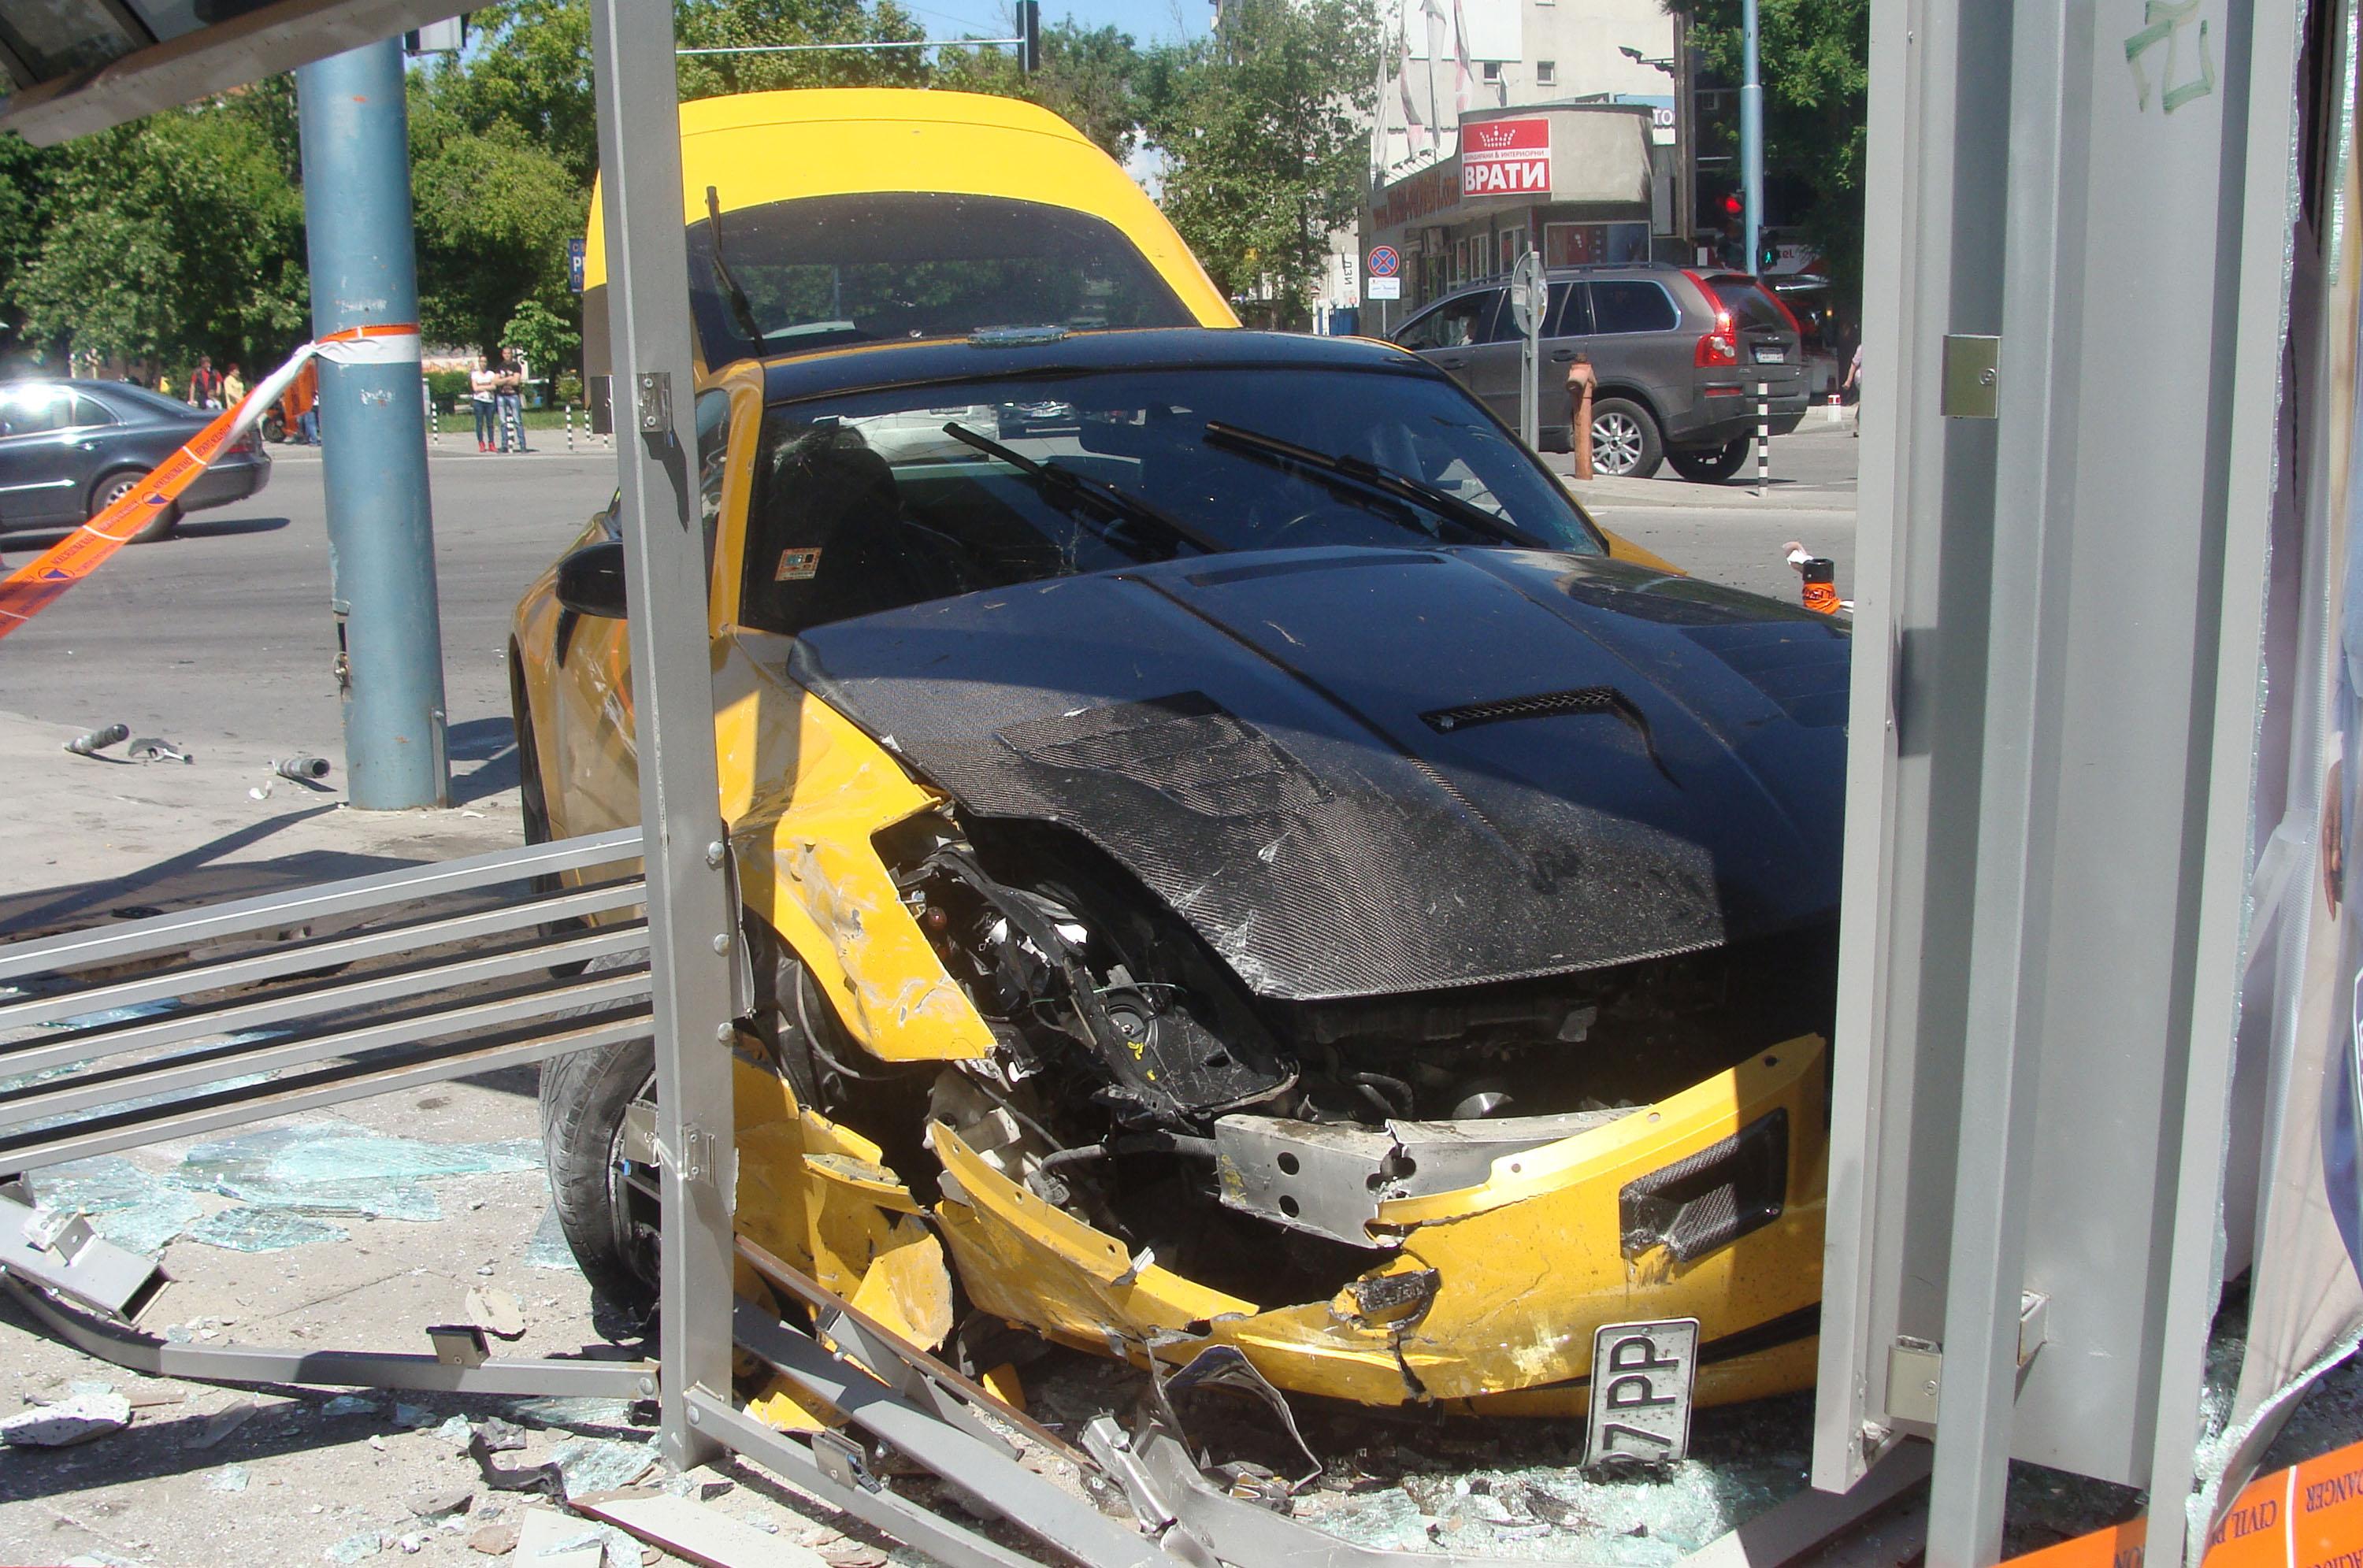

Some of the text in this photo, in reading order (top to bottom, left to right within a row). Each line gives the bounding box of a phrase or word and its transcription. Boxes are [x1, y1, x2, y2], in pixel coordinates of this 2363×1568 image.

[1464, 161, 1545, 191] ВРАТИ
[1601, 1335, 1679, 1462] 7PP
[2232, 1499, 2277, 1538] CIVIL
